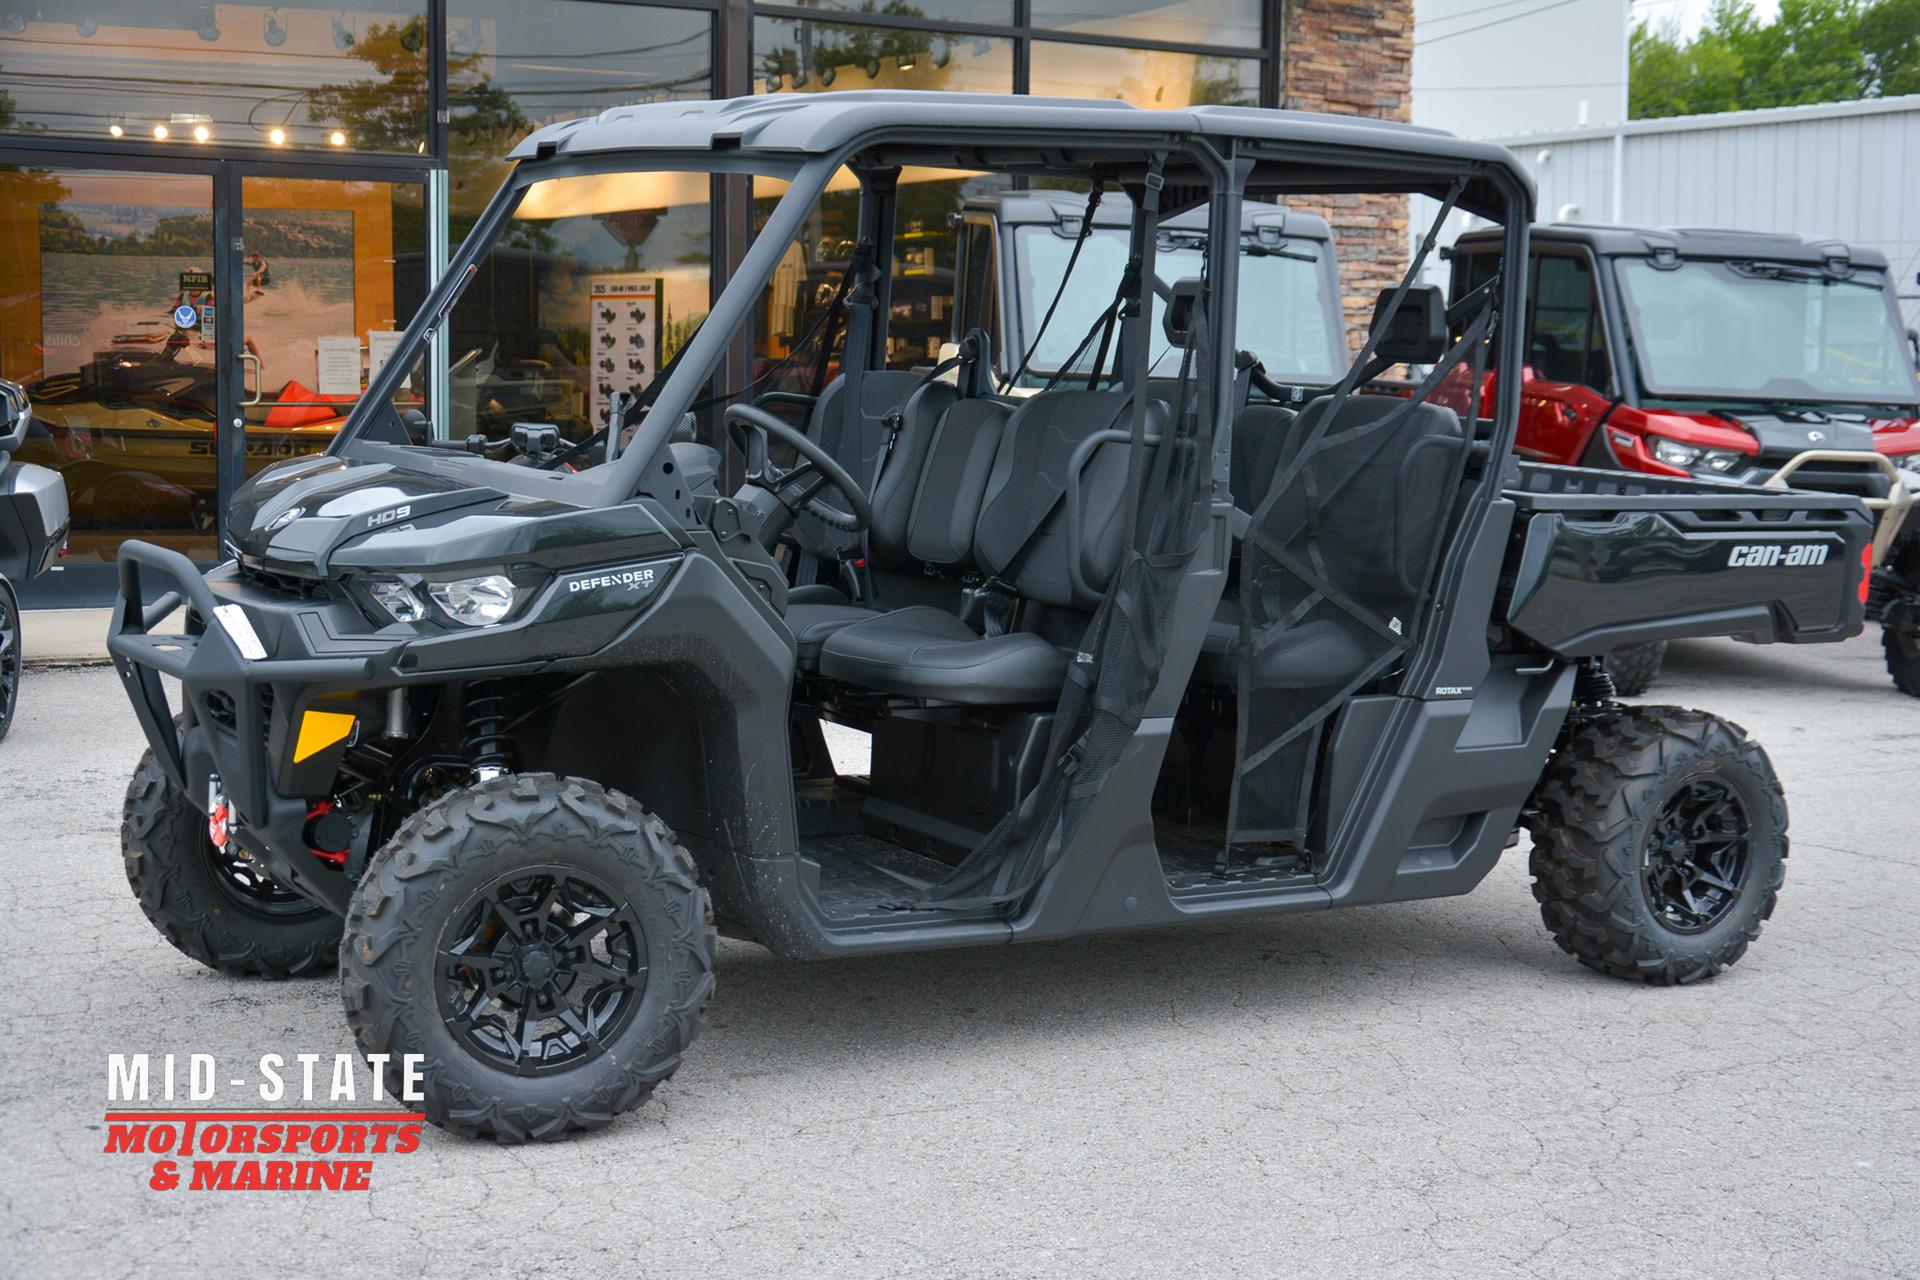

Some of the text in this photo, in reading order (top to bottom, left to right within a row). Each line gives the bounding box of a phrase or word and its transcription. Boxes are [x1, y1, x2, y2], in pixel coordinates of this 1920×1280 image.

[367, 505, 411, 527] HD9
[568, 569, 654, 592] DEFENDER
[626, 579, 654, 591] XT
[1435, 686, 1463, 695] ROTAX
